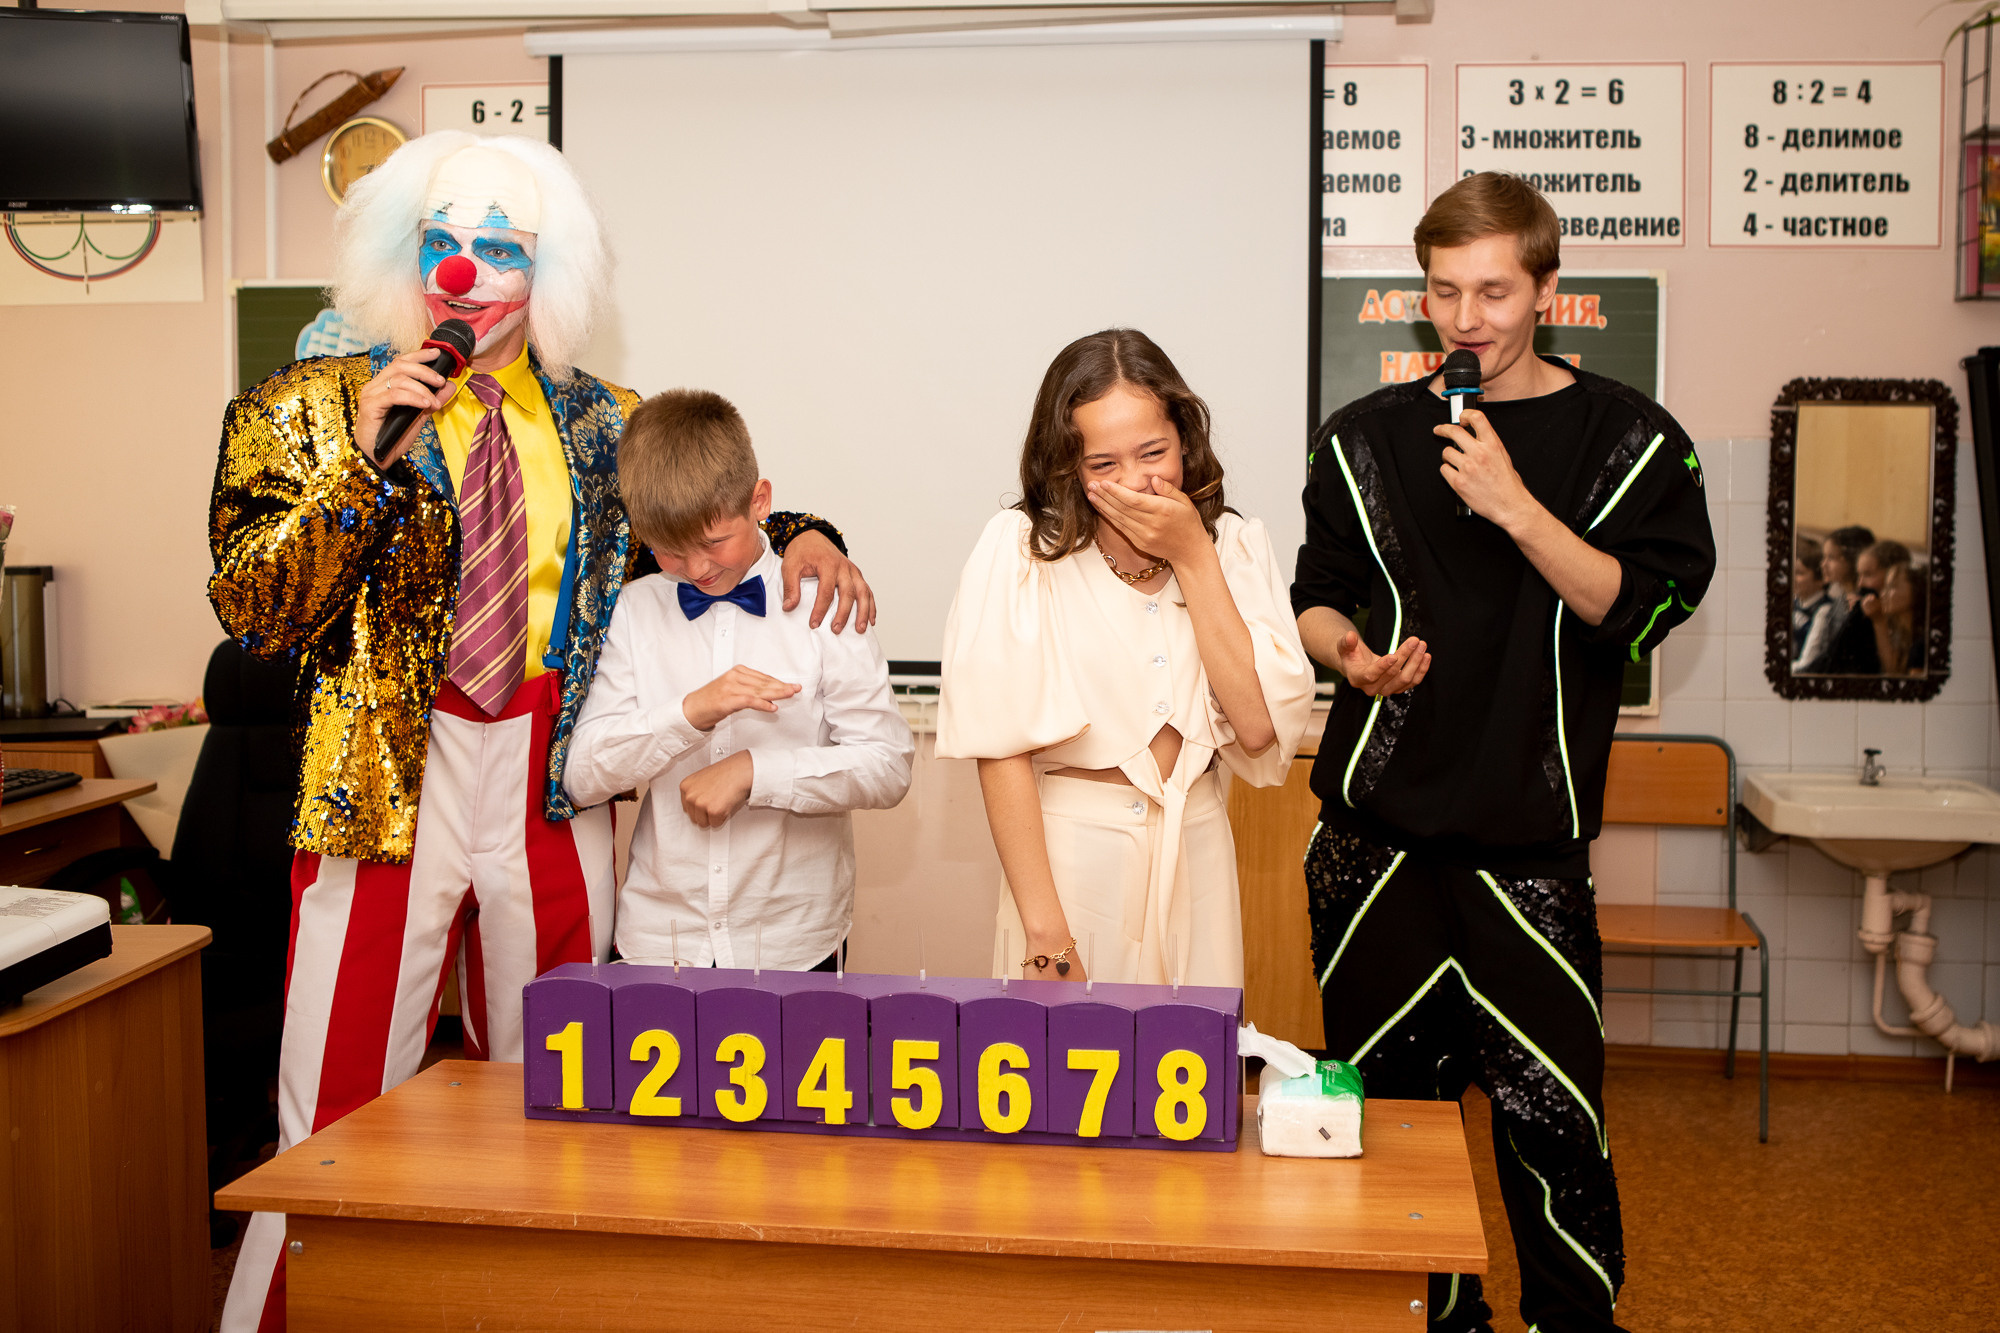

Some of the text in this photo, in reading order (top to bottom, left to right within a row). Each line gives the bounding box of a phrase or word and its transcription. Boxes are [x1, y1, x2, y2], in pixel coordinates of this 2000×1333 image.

[1344, 82, 1357, 106] 8
[1509, 79, 1525, 105] 3
[1555, 79, 1570, 105] 2
[1608, 79, 1624, 105] 6
[1773, 80, 1787, 104] 8
[1811, 80, 1824, 104] 2
[1857, 80, 1872, 104] 4
[472, 100, 485, 123] 6
[511, 100, 523, 122] 2
[1323, 129, 1400, 150] аемое
[1461, 125, 1475, 149] 3
[1493, 130, 1641, 149] множитель
[1745, 124, 1759, 148] 8
[1782, 128, 1902, 152] делимое
[1322, 173, 1401, 193] аемое
[1521, 173, 1641, 193] ожитель
[1744, 168, 1757, 192] 2
[1780, 173, 1910, 196] делитель
[1559, 216, 1680, 240] зведение
[1743, 213, 1758, 236] 4
[1783, 216, 1888, 237] частное
[546, 1022, 1207, 1141] 1 2 3 4 5 6 7 8
